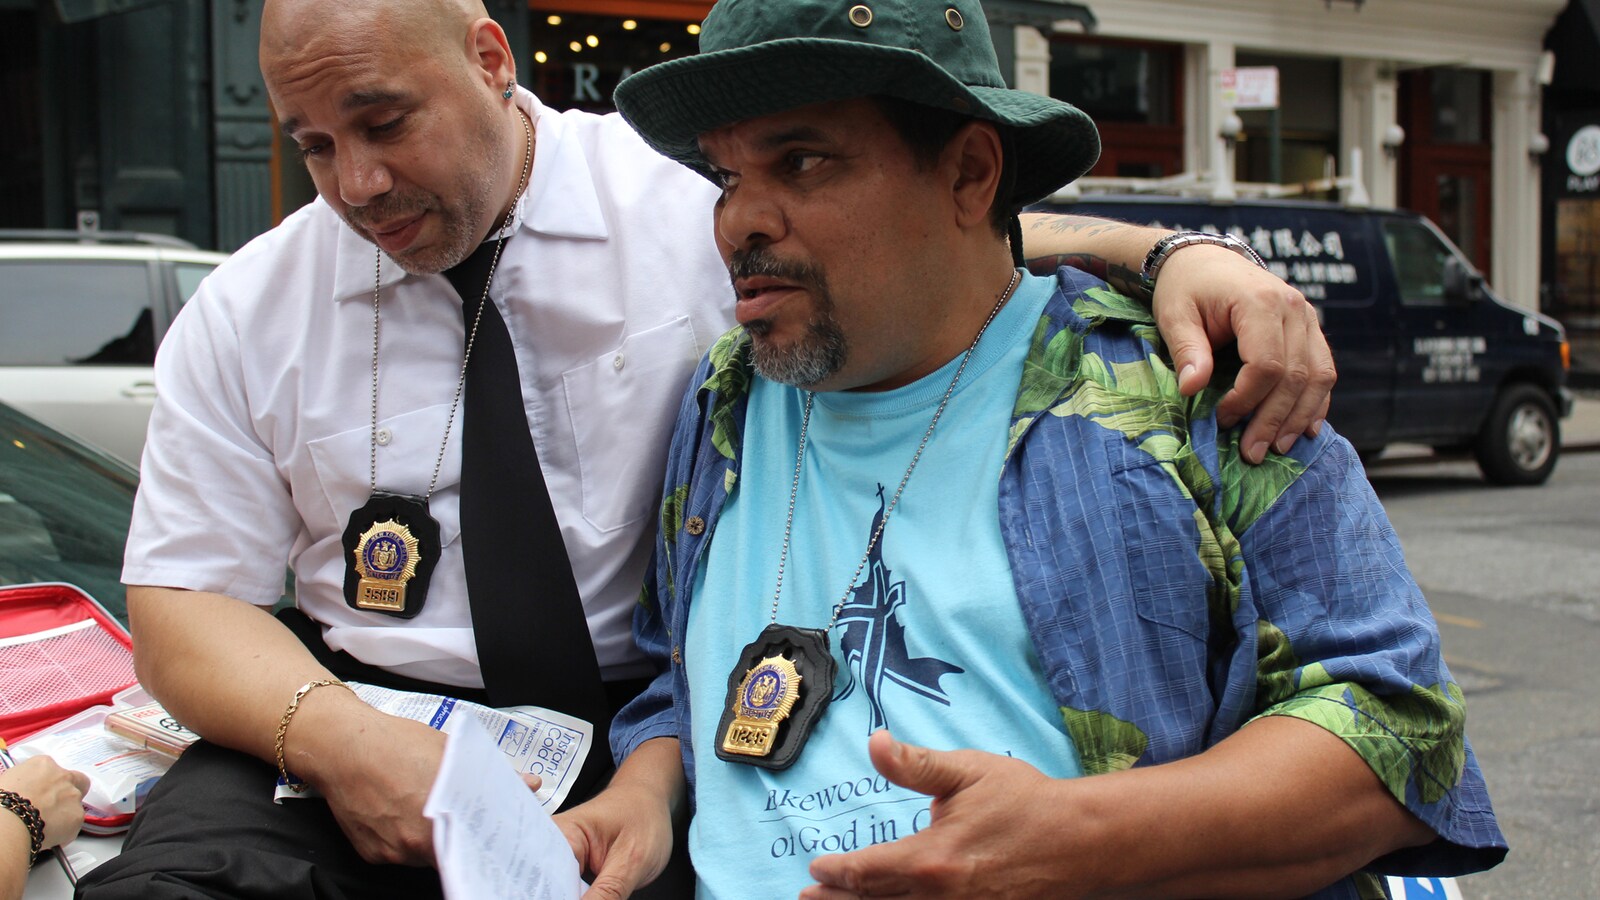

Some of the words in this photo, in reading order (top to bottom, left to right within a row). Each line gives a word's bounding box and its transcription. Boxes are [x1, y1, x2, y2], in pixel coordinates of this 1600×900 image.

[371, 531, 384, 542] NEW
[537, 727, 562, 761] Cold
[545, 732, 575, 777] Instant
[798, 818, 859, 853] God
[870, 814, 899, 846] in
